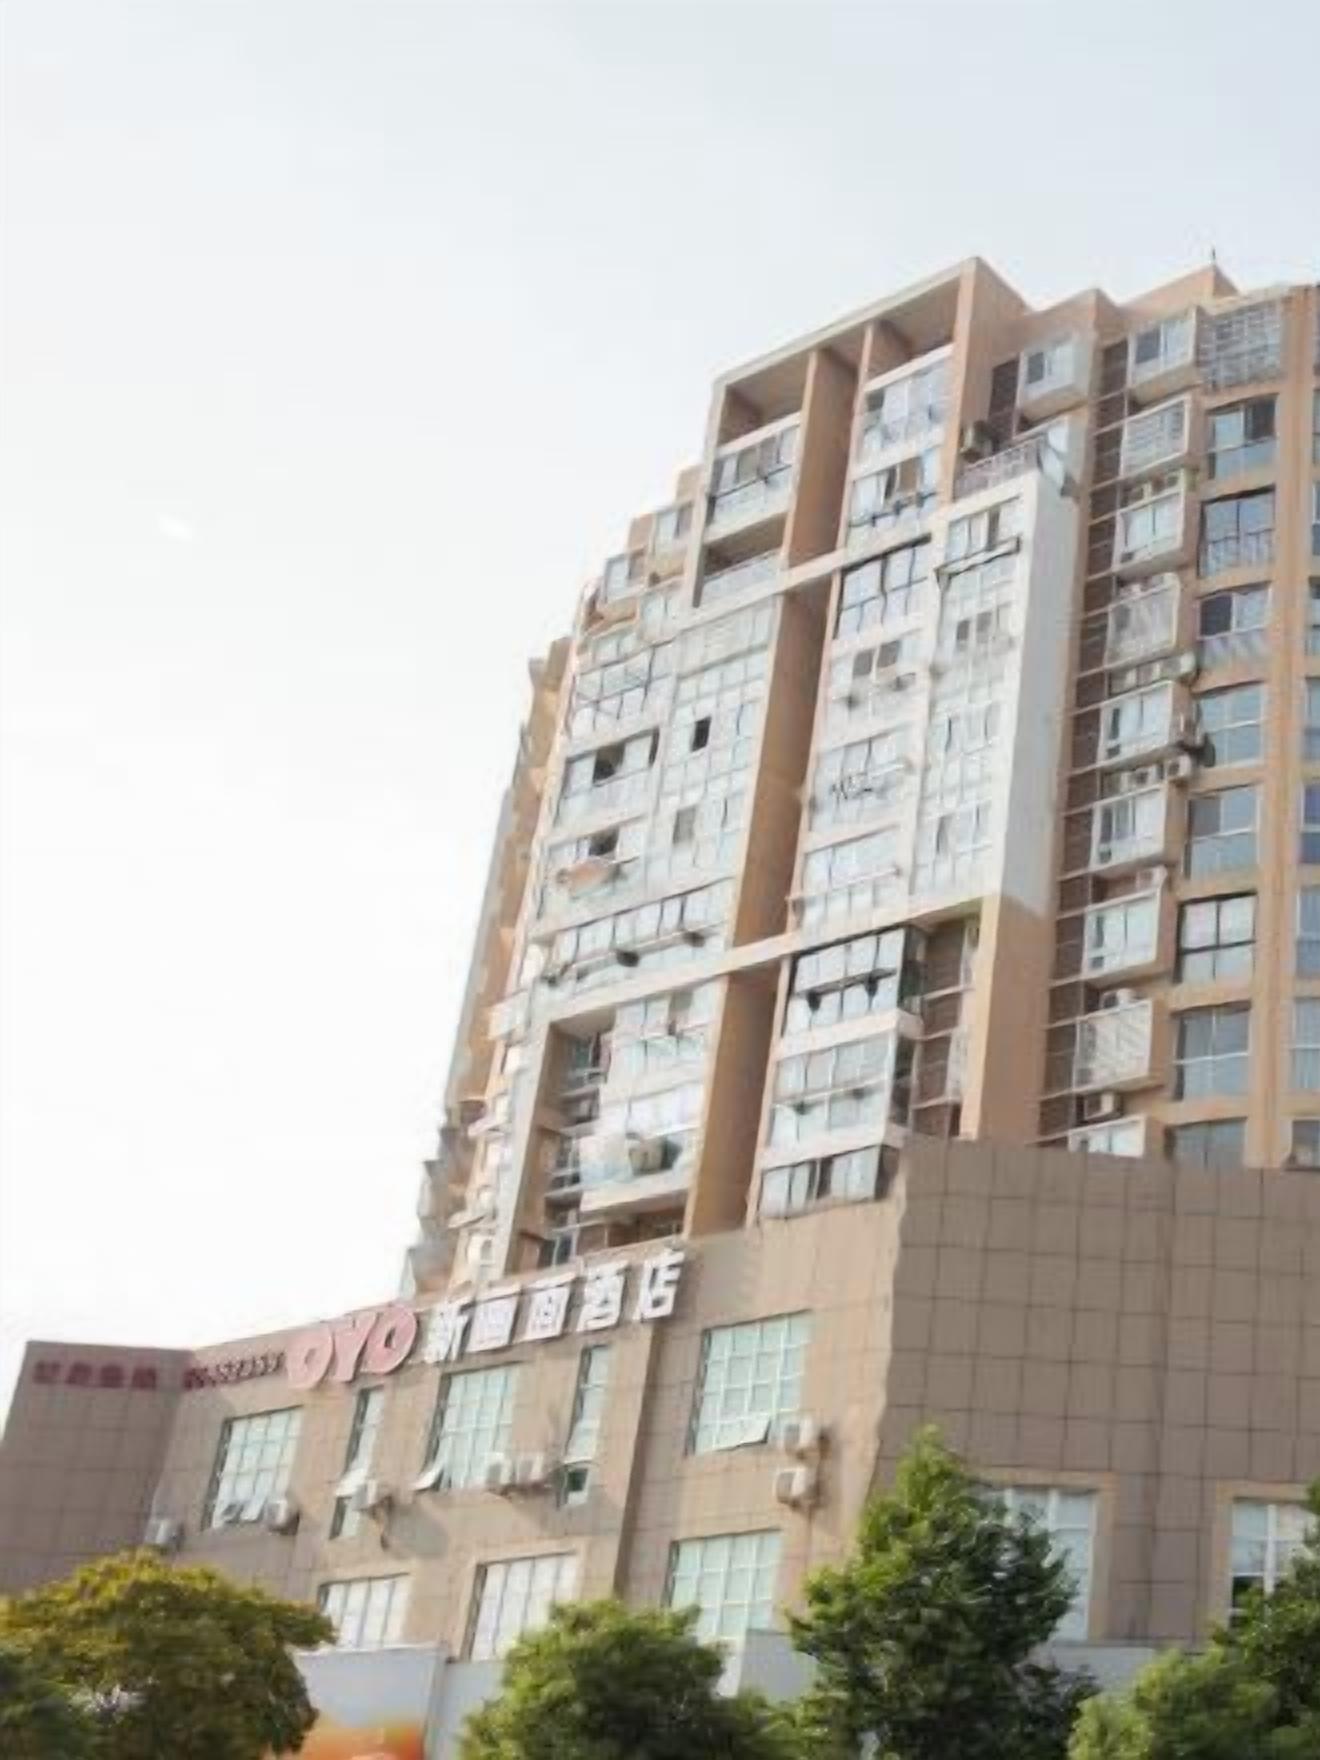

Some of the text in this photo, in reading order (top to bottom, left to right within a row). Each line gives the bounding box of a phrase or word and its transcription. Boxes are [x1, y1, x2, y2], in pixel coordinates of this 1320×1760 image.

[287, 1303, 418, 1390] OYO
[426, 1249, 685, 1364] 新画面酒店
